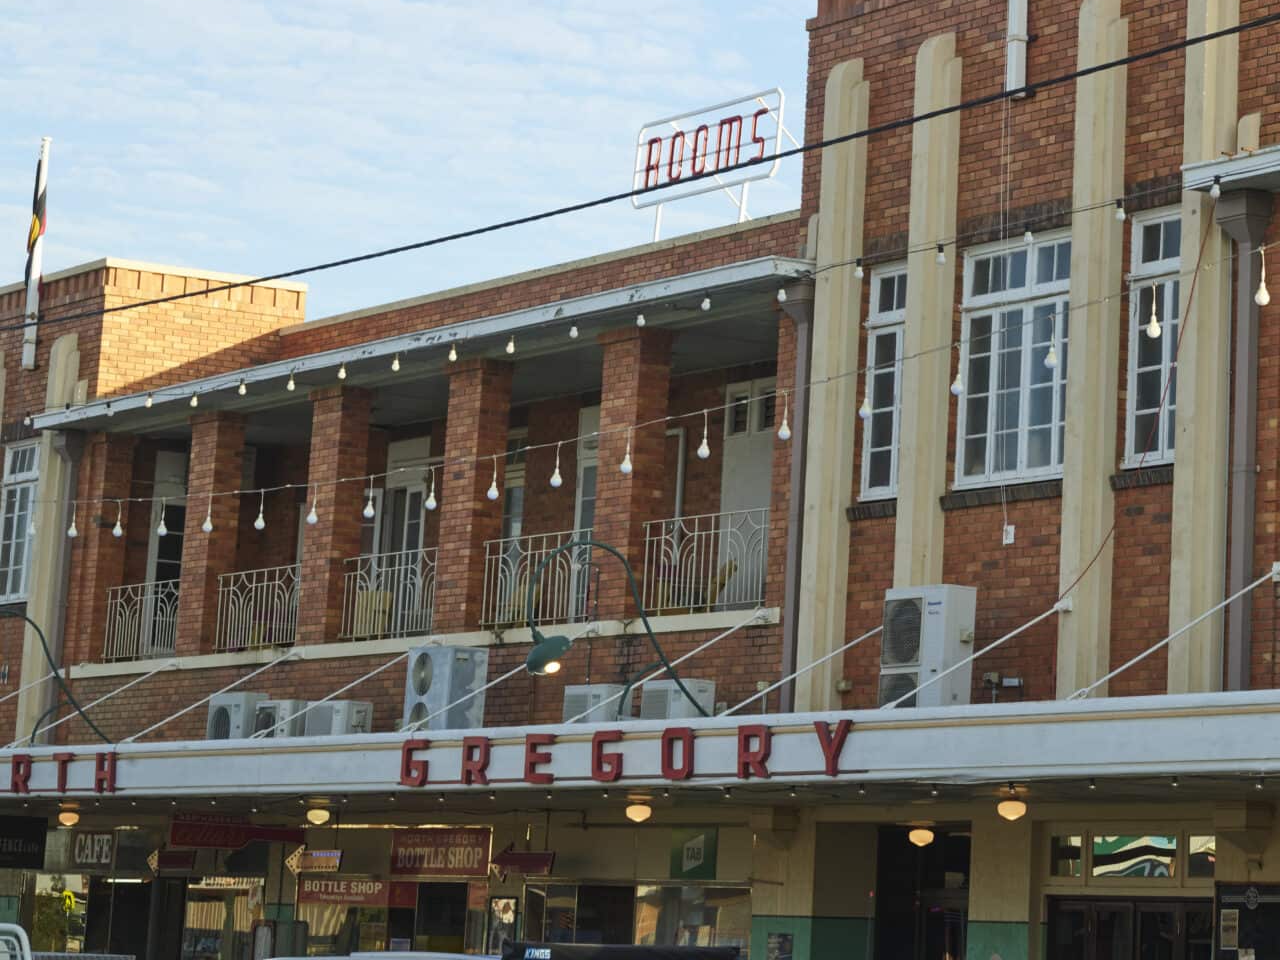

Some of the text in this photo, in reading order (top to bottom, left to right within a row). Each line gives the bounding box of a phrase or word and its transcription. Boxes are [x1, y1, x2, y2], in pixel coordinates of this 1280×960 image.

[644, 108, 769, 190] ROOMS
[400, 719, 853, 787] GREGORY
[75, 833, 112, 864] CAFE
[397, 846, 483, 869] BOTTLE SHOP
[304, 880, 383, 894] BOTTLE SHOP
